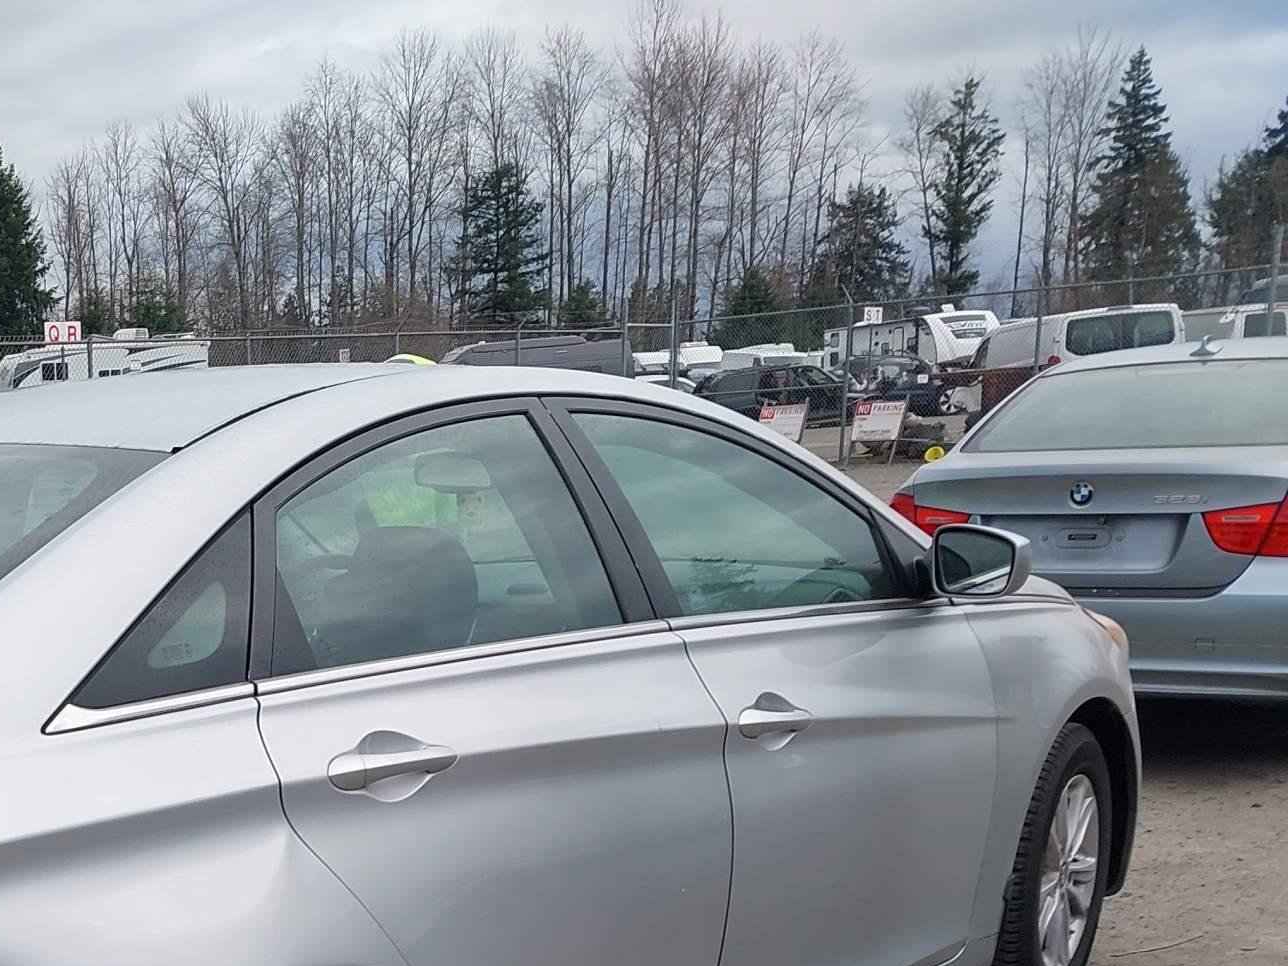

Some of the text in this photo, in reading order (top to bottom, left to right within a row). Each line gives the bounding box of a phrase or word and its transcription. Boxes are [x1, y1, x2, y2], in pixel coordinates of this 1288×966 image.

[865, 309, 872, 321] S
[48, 325, 77, 342] Q R
[762, 406, 804, 418] NO PARKING
[858, 403, 904, 415] NO PARKING
